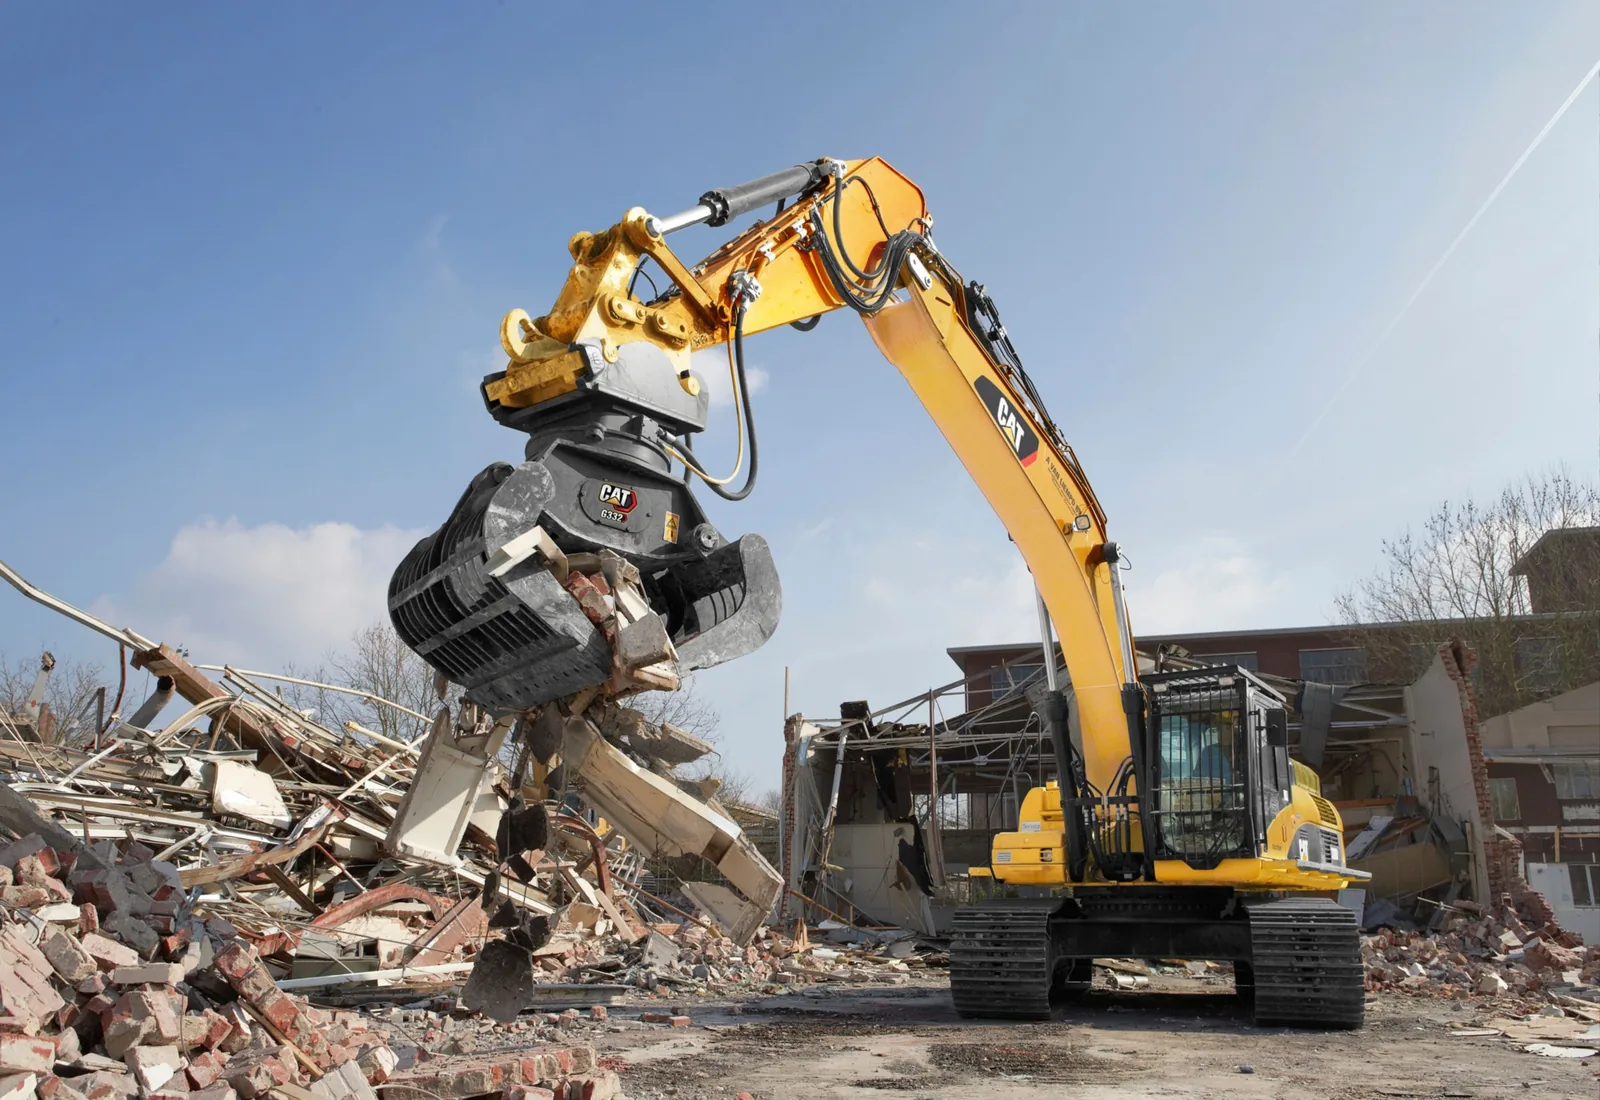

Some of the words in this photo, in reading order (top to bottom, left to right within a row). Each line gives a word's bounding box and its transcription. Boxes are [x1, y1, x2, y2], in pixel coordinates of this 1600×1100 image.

[997, 397, 1024, 452] CAT
[1050, 463, 1060, 481] VAN
[600, 484, 631, 507] CAT
[601, 509, 623, 521] G332
